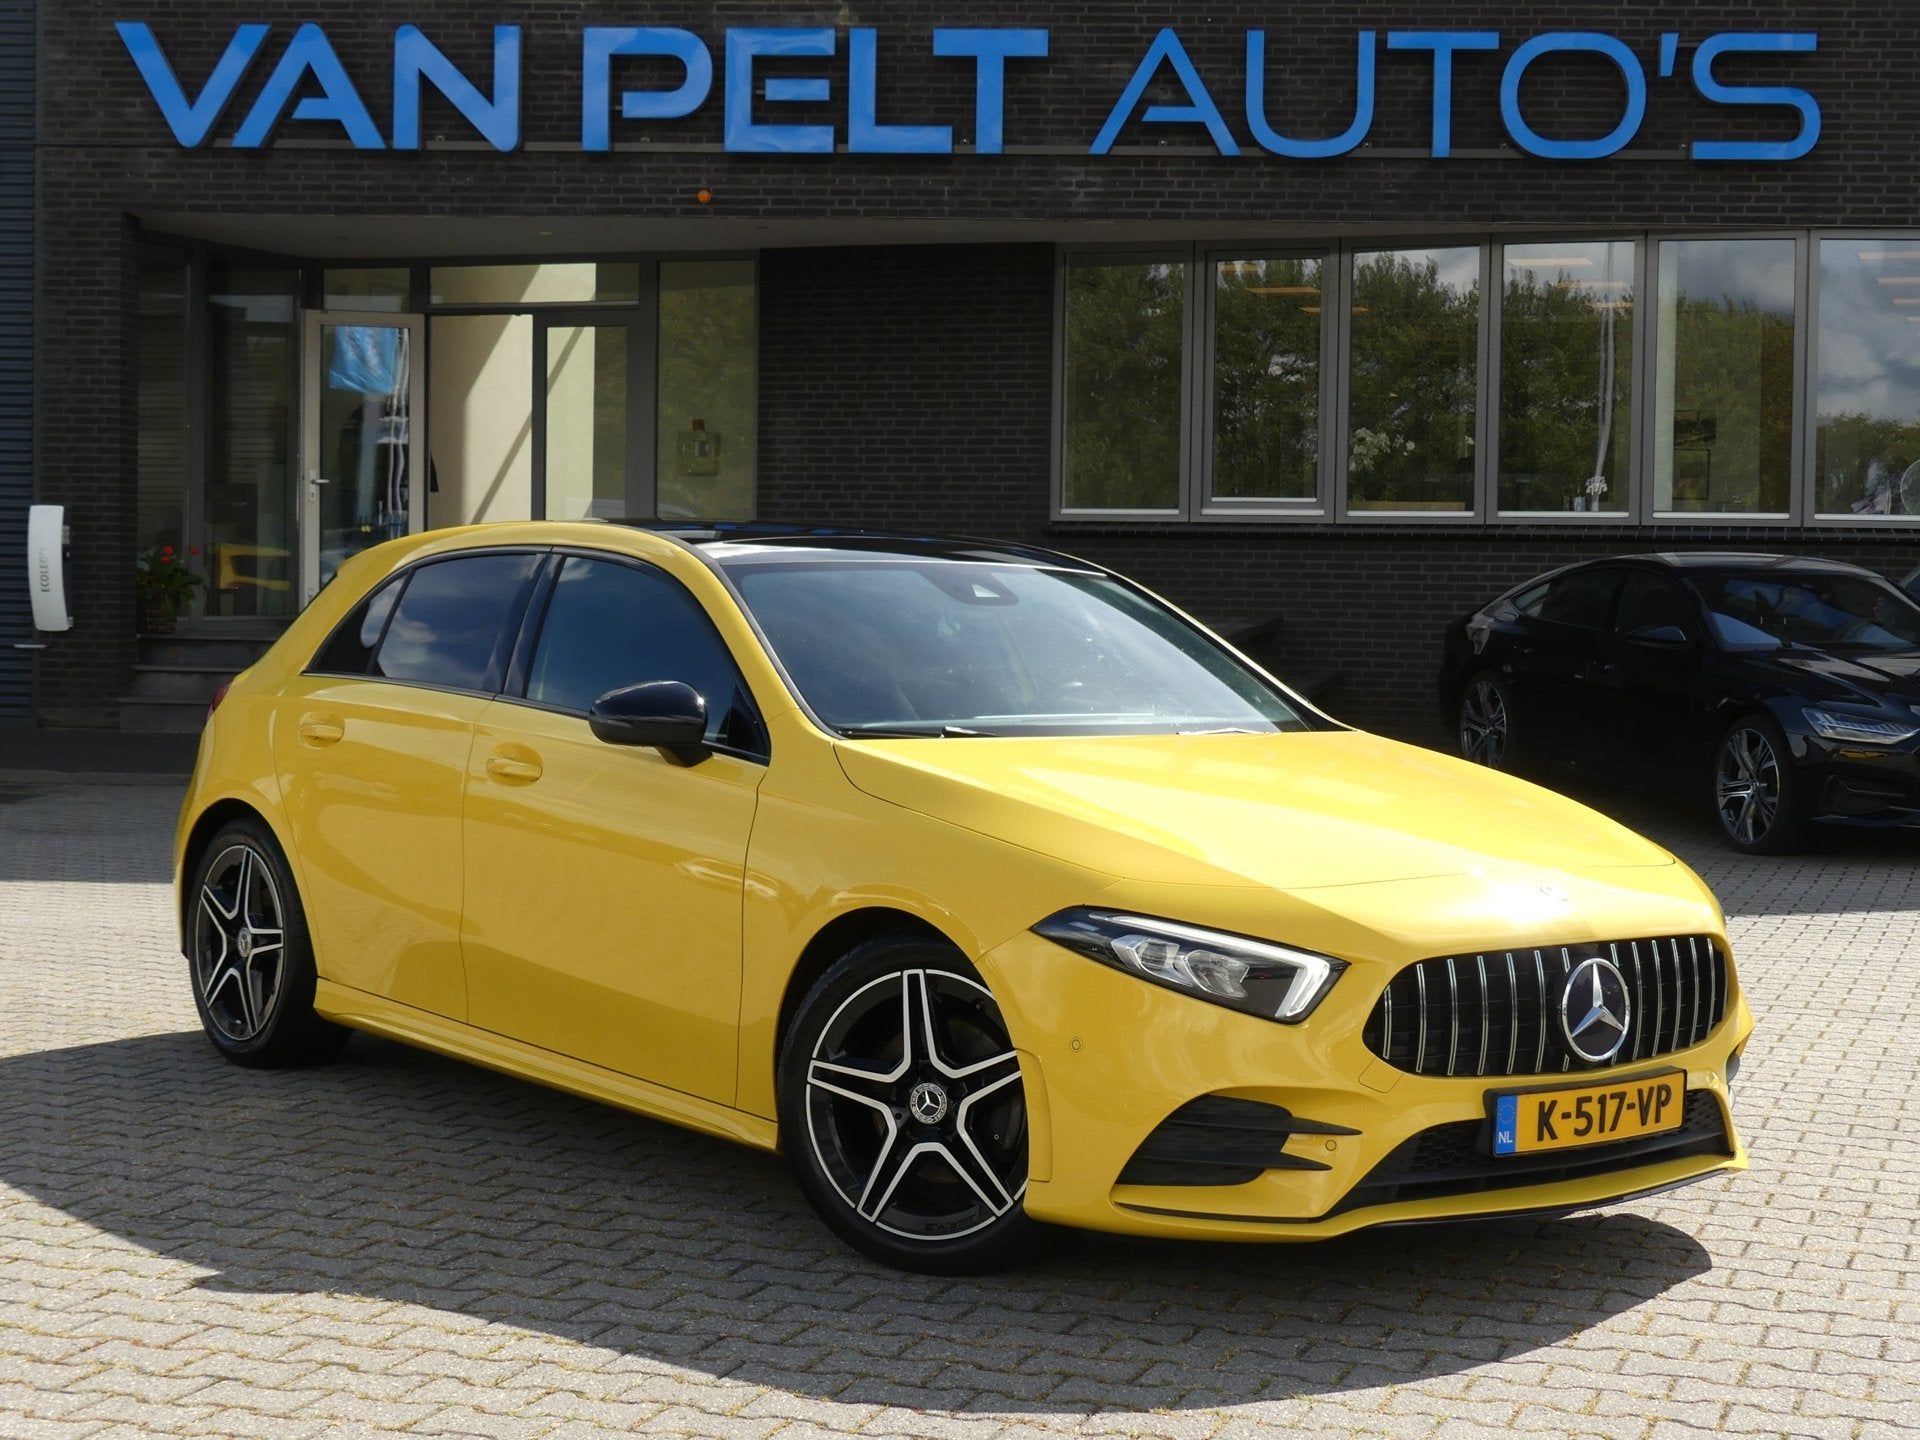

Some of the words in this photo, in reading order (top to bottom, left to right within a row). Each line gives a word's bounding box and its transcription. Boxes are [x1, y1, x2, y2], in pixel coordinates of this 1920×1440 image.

[116, 22, 521, 153] VAN
[580, 27, 1050, 156] PELT
[1088, 28, 1822, 161] AUTO'S
[1498, 1131, 1513, 1144] NL
[1537, 1083, 1672, 1142] K-517-VP
